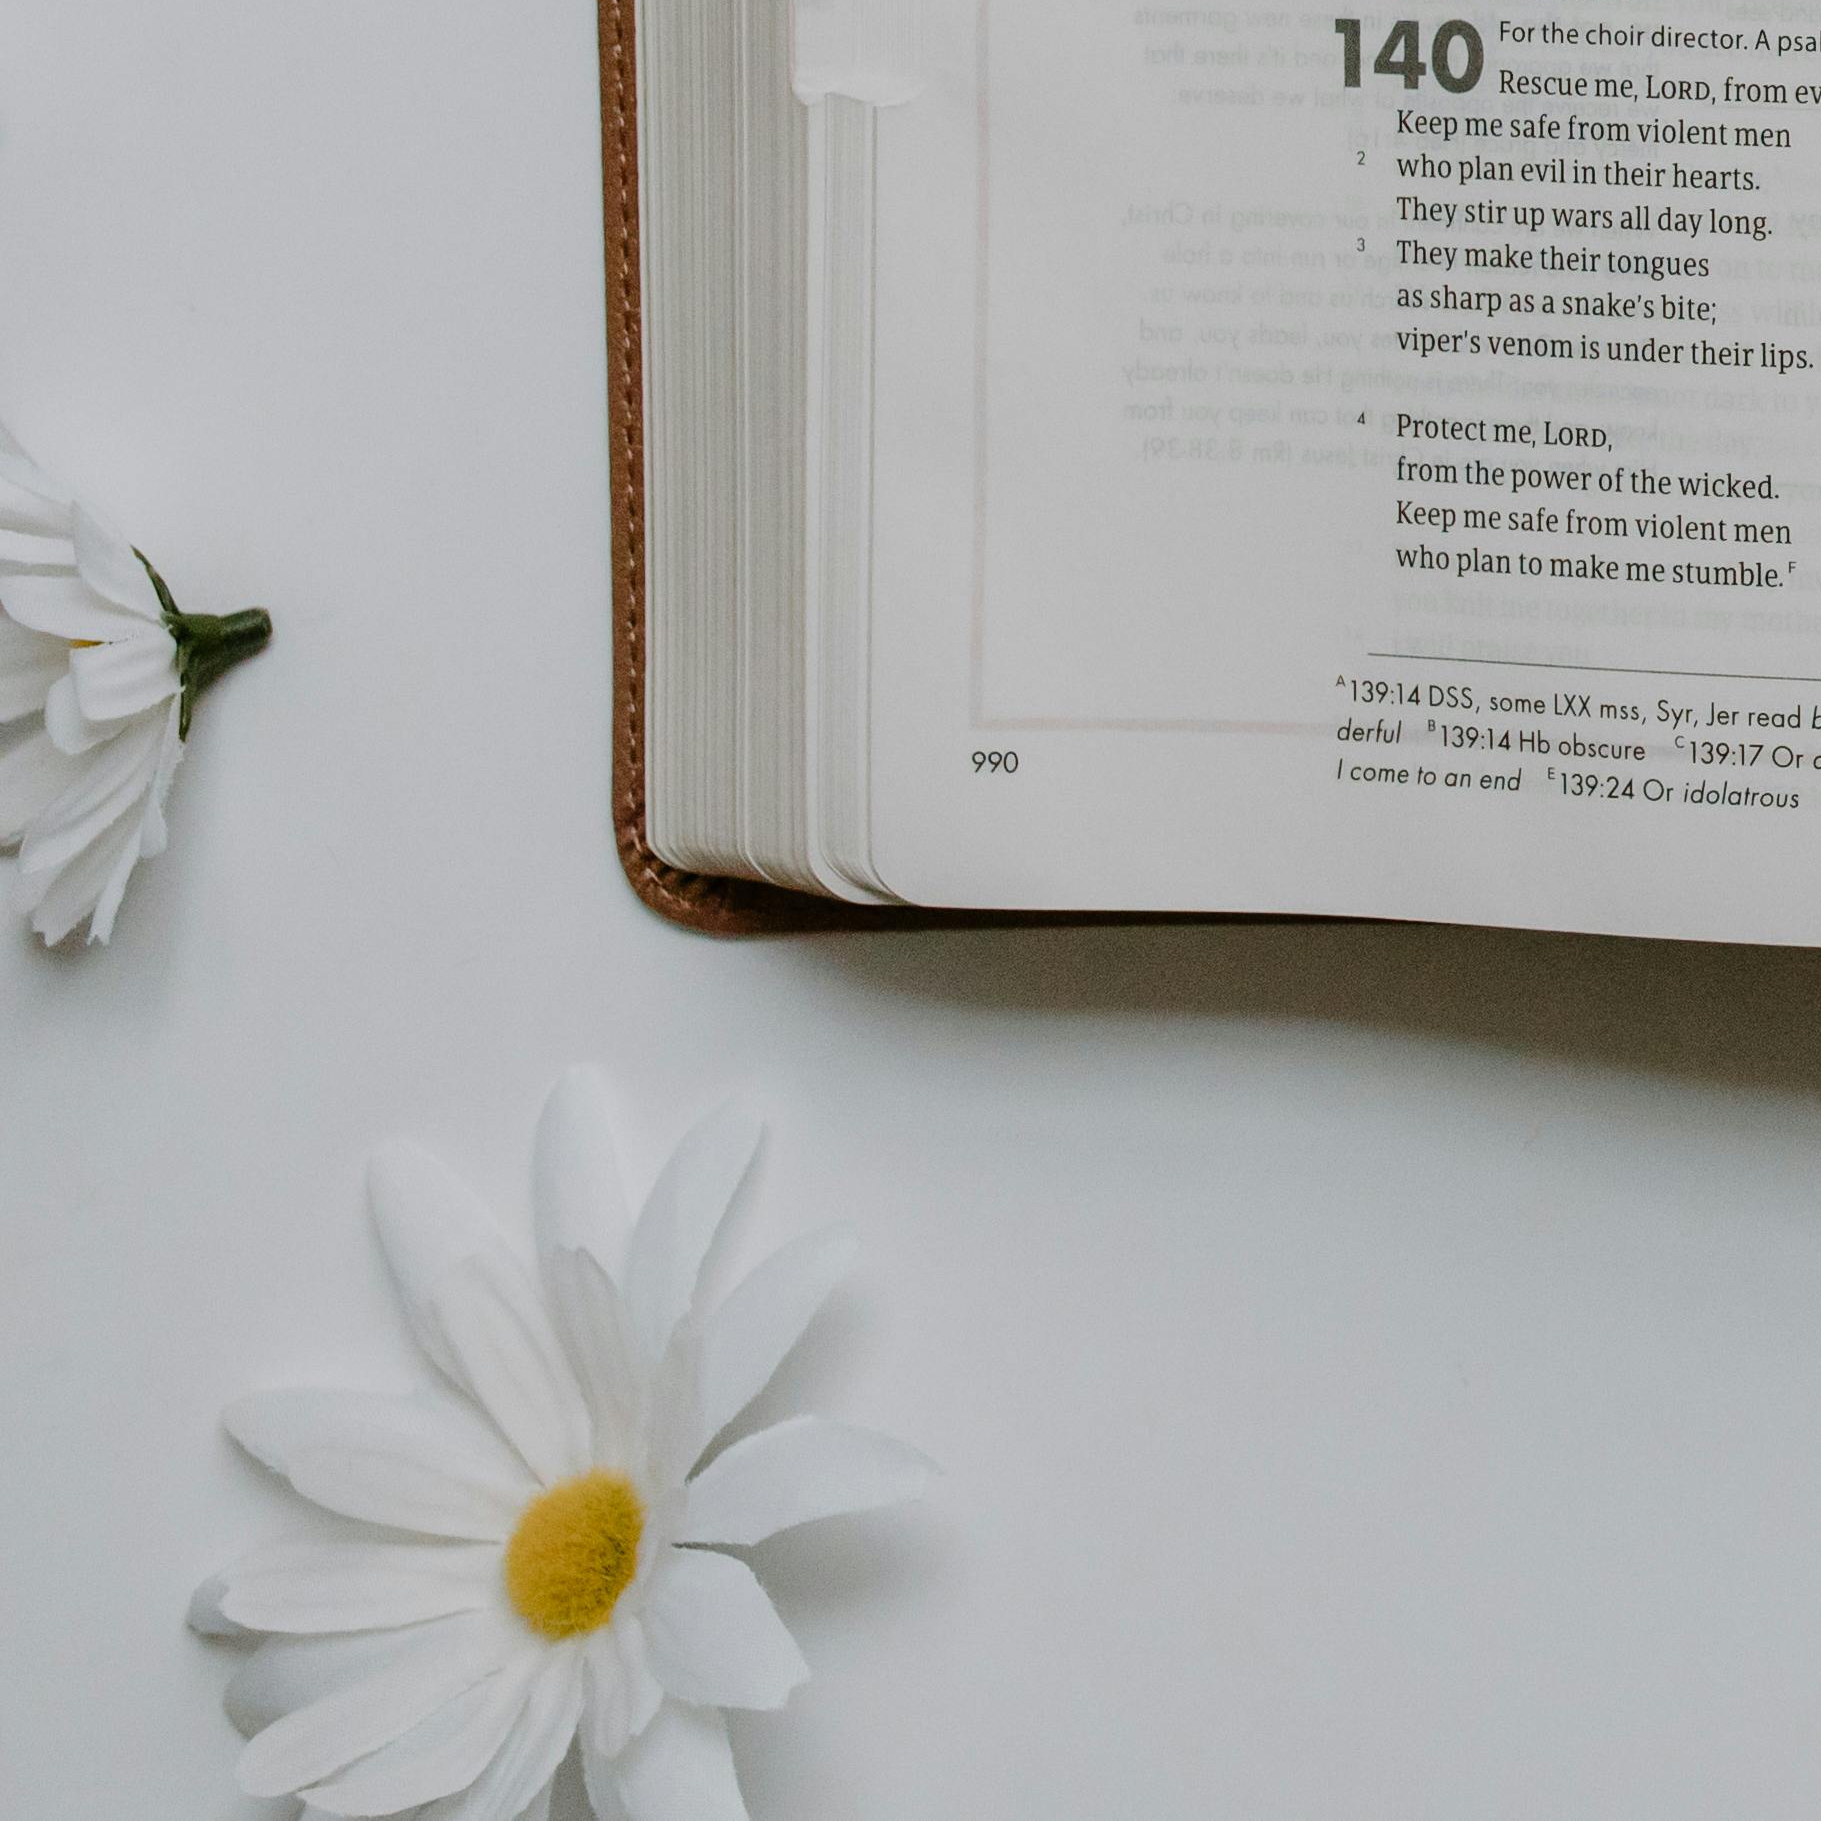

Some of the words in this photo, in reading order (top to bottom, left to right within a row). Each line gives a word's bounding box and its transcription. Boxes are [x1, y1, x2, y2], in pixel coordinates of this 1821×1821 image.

[1333, 16, 1485, 96] 140
[1498, 19, 1537, 44] For
[1540, 19, 1580, 46] the
[1584, 21, 1647, 48] choir
[1649, 23, 1749, 52] director.
[1753, 27, 1772, 52] A
[1395, 411, 1488, 443] Protect
[1491, 422, 1537, 450] me,
[1542, 419, 1614, 454] LORD,
[1428, 685, 1481, 714] DSS,
[1488, 695, 1547, 716] some
[1552, 692, 1592, 717] LXX
[1599, 702, 1648, 725] mss,
[1655, 699, 1700, 730] Syr,
[1704, 701, 1740, 728] Jer
[1747, 703, 1802, 730] read
[970, 749, 1020, 775] 990
[1335, 756, 1345, 781] I
[1348, 765, 1411, 785] come
[1416, 764, 1438, 787] to
[1443, 770, 1473, 790] an
[1478, 766, 1523, 793] end
[1641, 777, 1676, 804] Or
[1682, 778, 1801, 810] idolatrous
